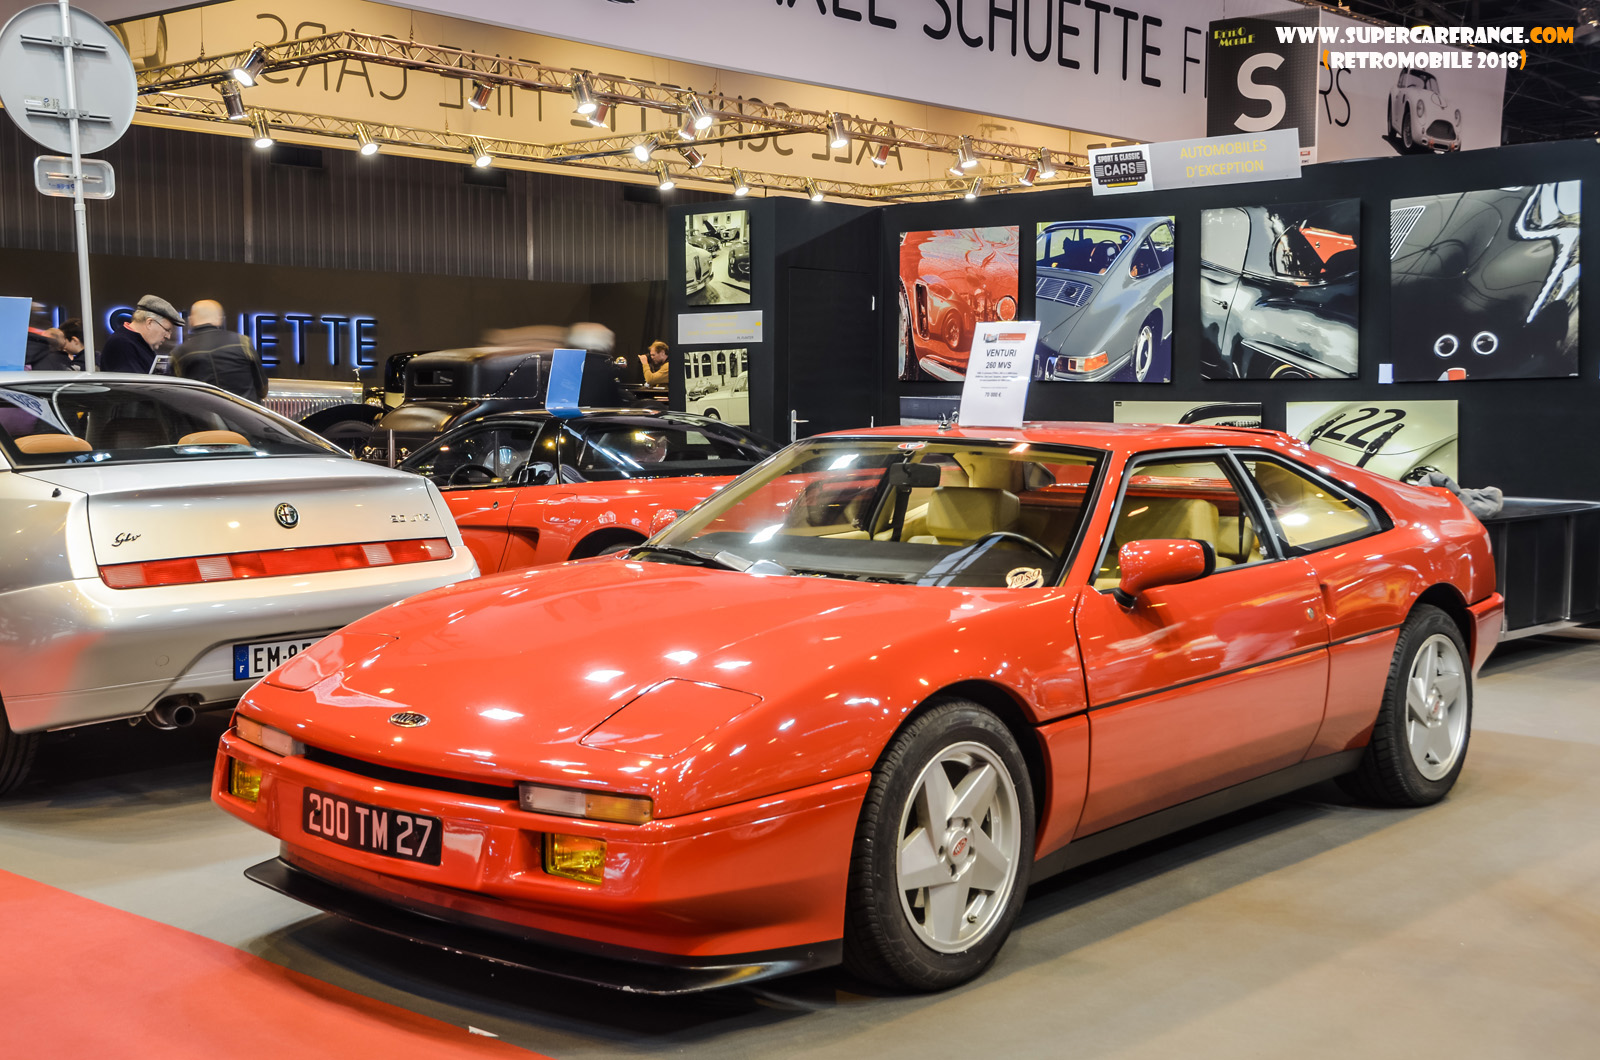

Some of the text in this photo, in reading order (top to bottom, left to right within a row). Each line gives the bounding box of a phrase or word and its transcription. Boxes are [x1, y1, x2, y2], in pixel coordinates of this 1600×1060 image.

[923, 0, 1163, 88] SCHUETTE
[1233, 52, 1286, 132] S
[1098, 154, 1114, 163] SPORT
[1119, 152, 1141, 161] CLASSIC
[1180, 139, 1267, 159] AUTOMOBILES
[1104, 162, 1136, 176] CARS
[1186, 160, 1264, 178] D'EXCEPTION
[986, 349, 1017, 357] VENTURI
[998, 361, 1012, 369] MVS
[254, 643, 312, 673] EM-8
[240, 665, 245, 673] F
[309, 793, 433, 858] 200 TM 27
